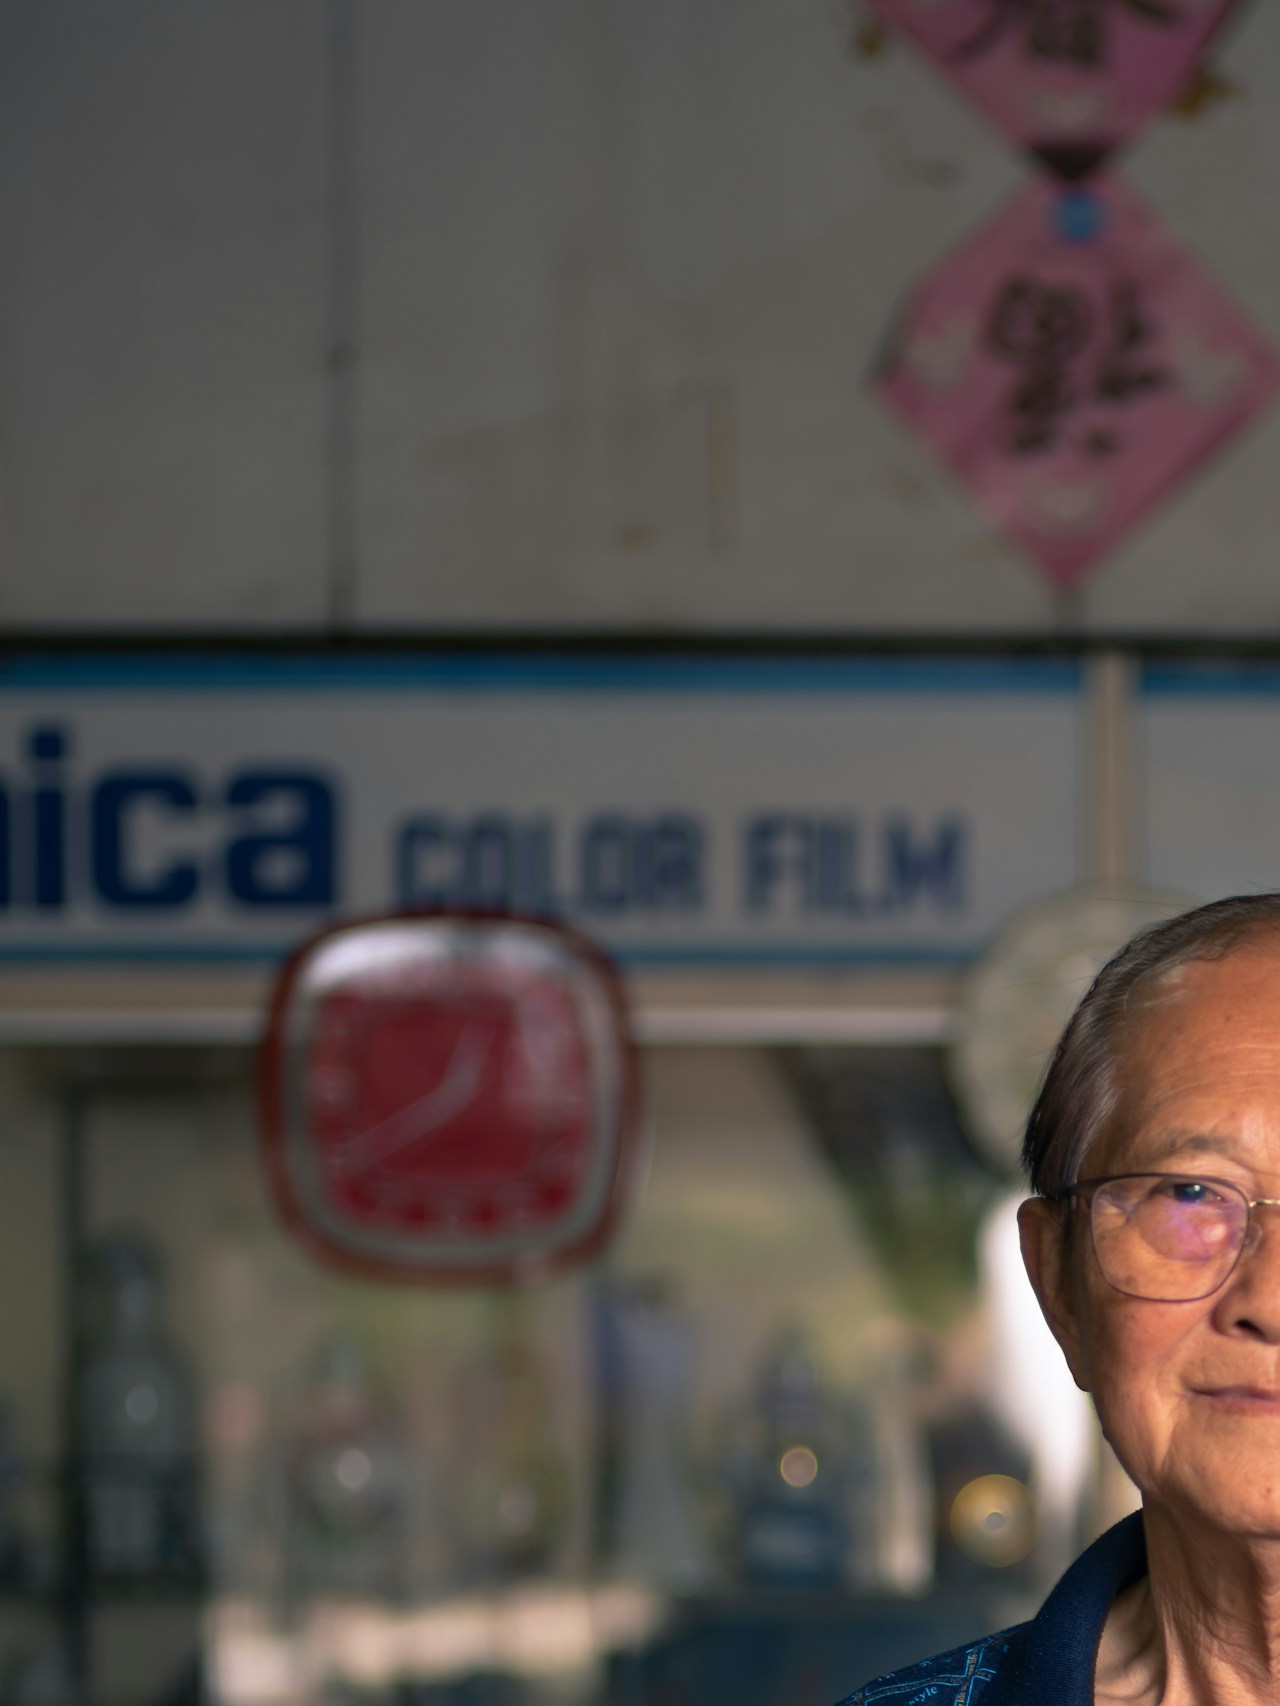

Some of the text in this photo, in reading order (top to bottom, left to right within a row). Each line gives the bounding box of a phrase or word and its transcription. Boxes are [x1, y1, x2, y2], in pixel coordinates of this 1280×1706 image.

[0, 731, 968, 912] ica COLOR FILM
